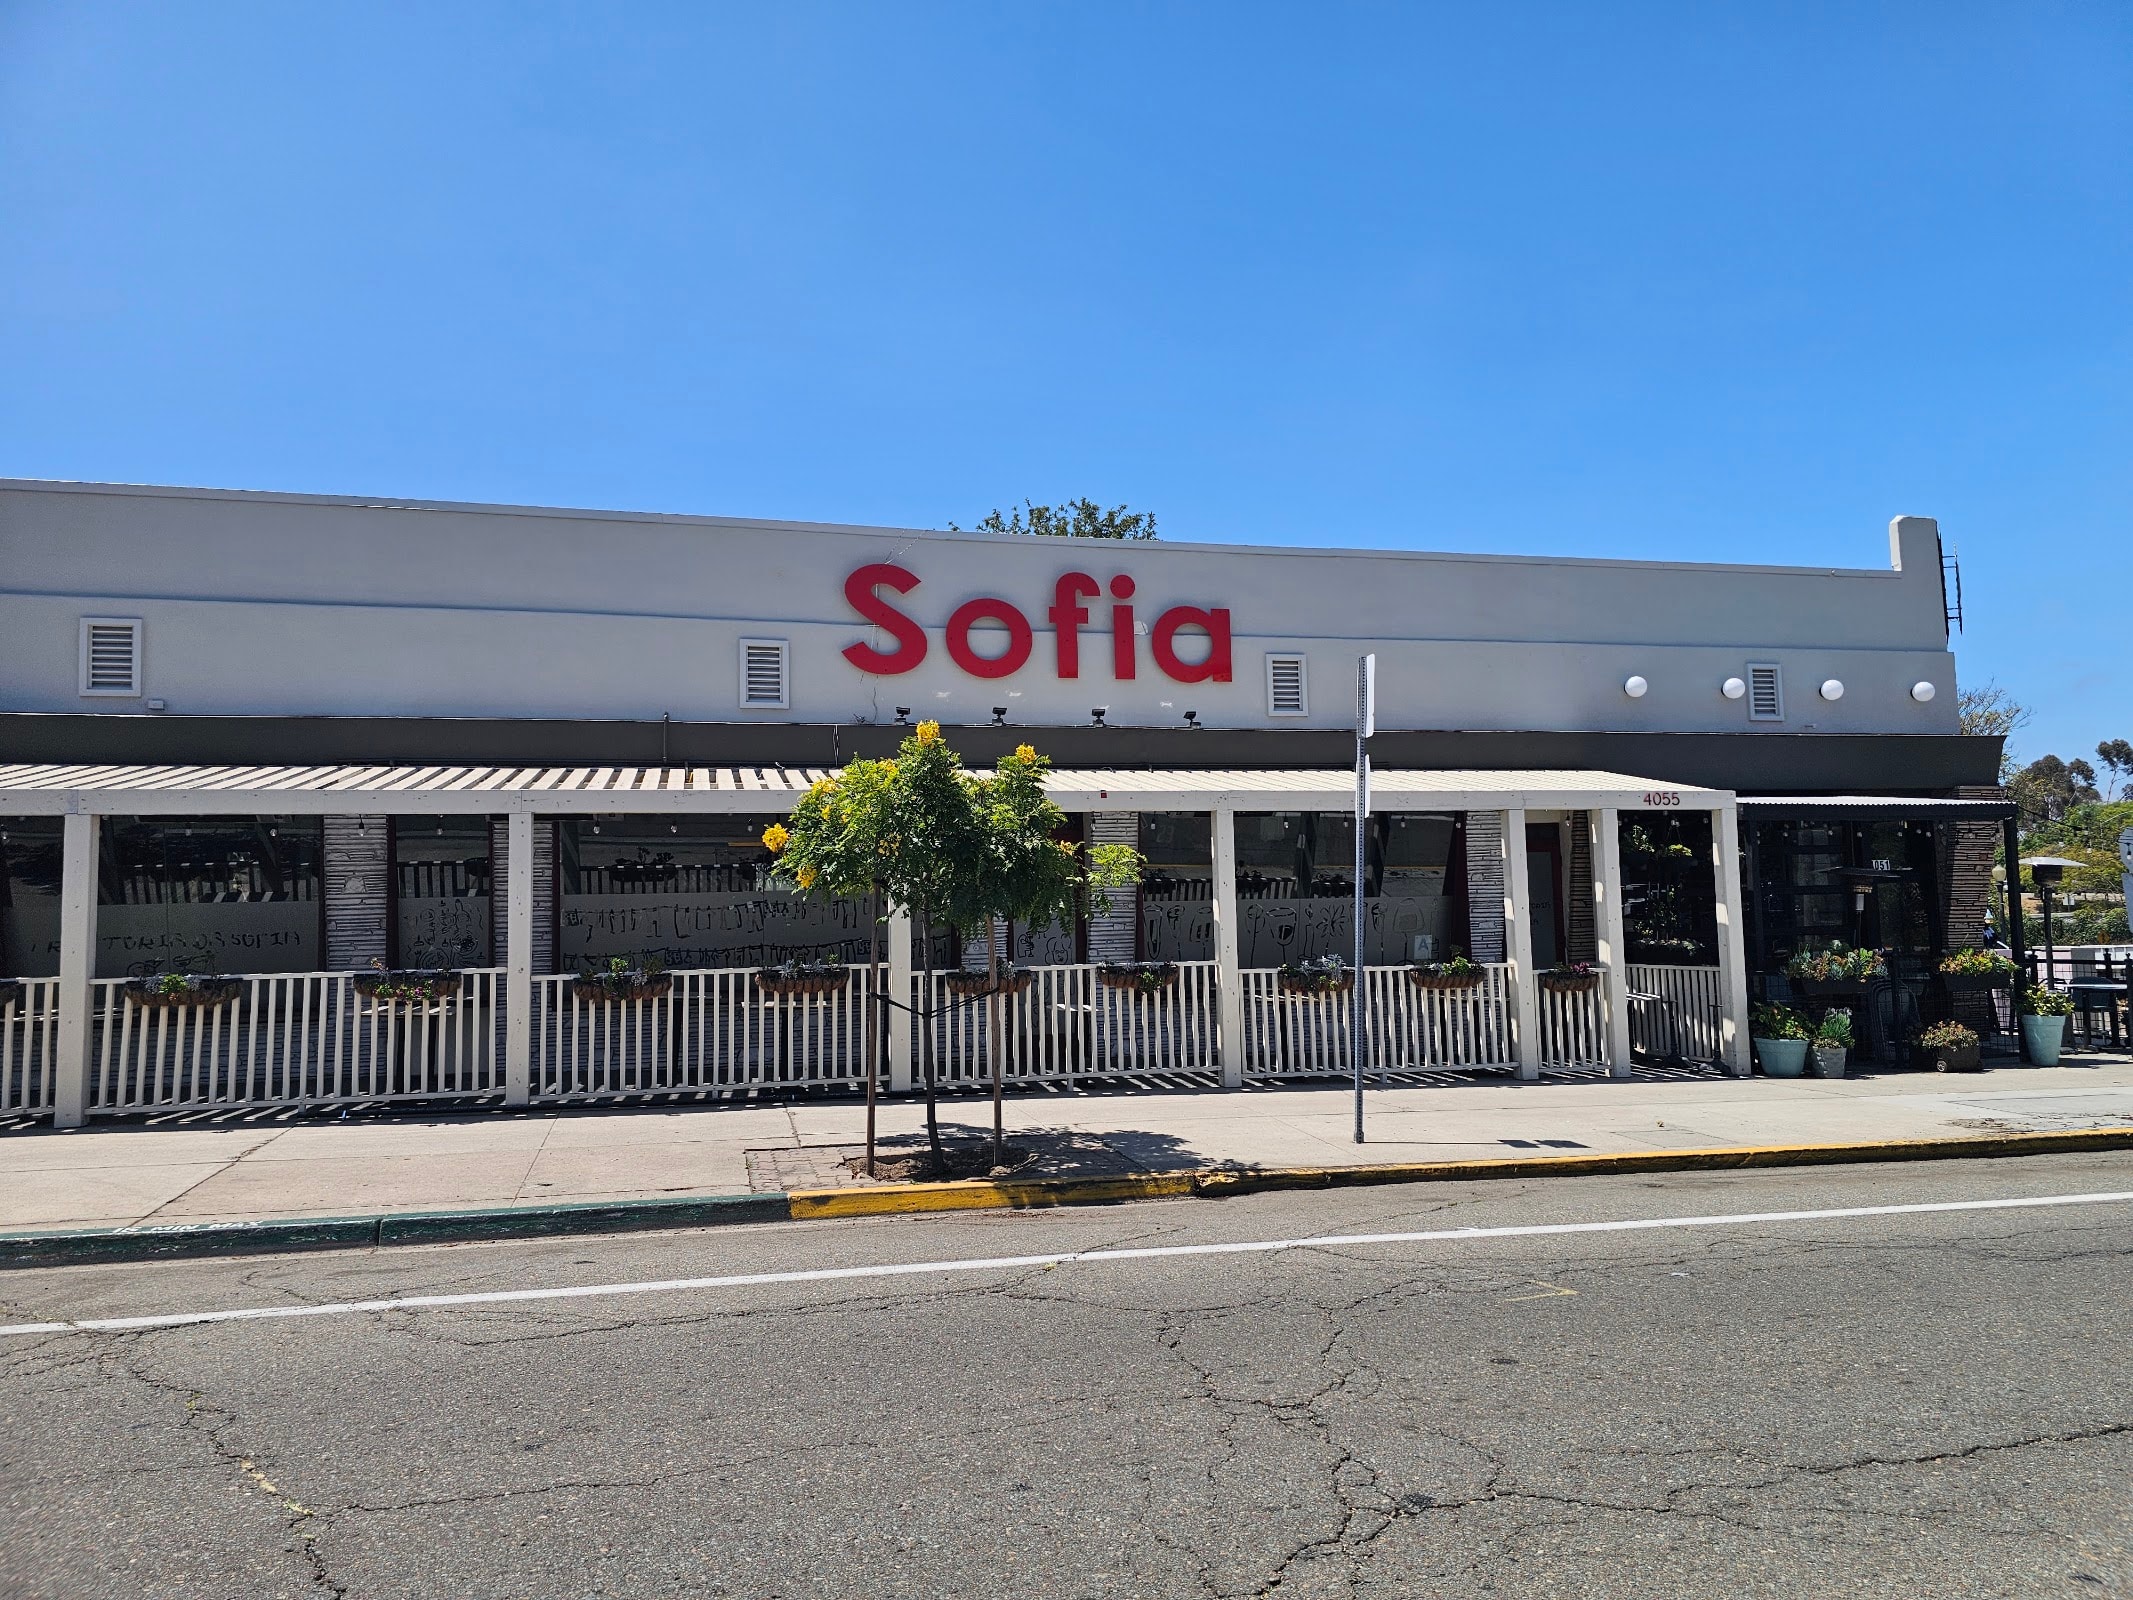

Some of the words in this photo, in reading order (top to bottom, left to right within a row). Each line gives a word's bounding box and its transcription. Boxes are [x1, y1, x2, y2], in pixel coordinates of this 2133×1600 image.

[841, 563, 1233, 684] Sofia
[1643, 792, 1681, 806] 4055
[1418, 937, 1428, 951] A
